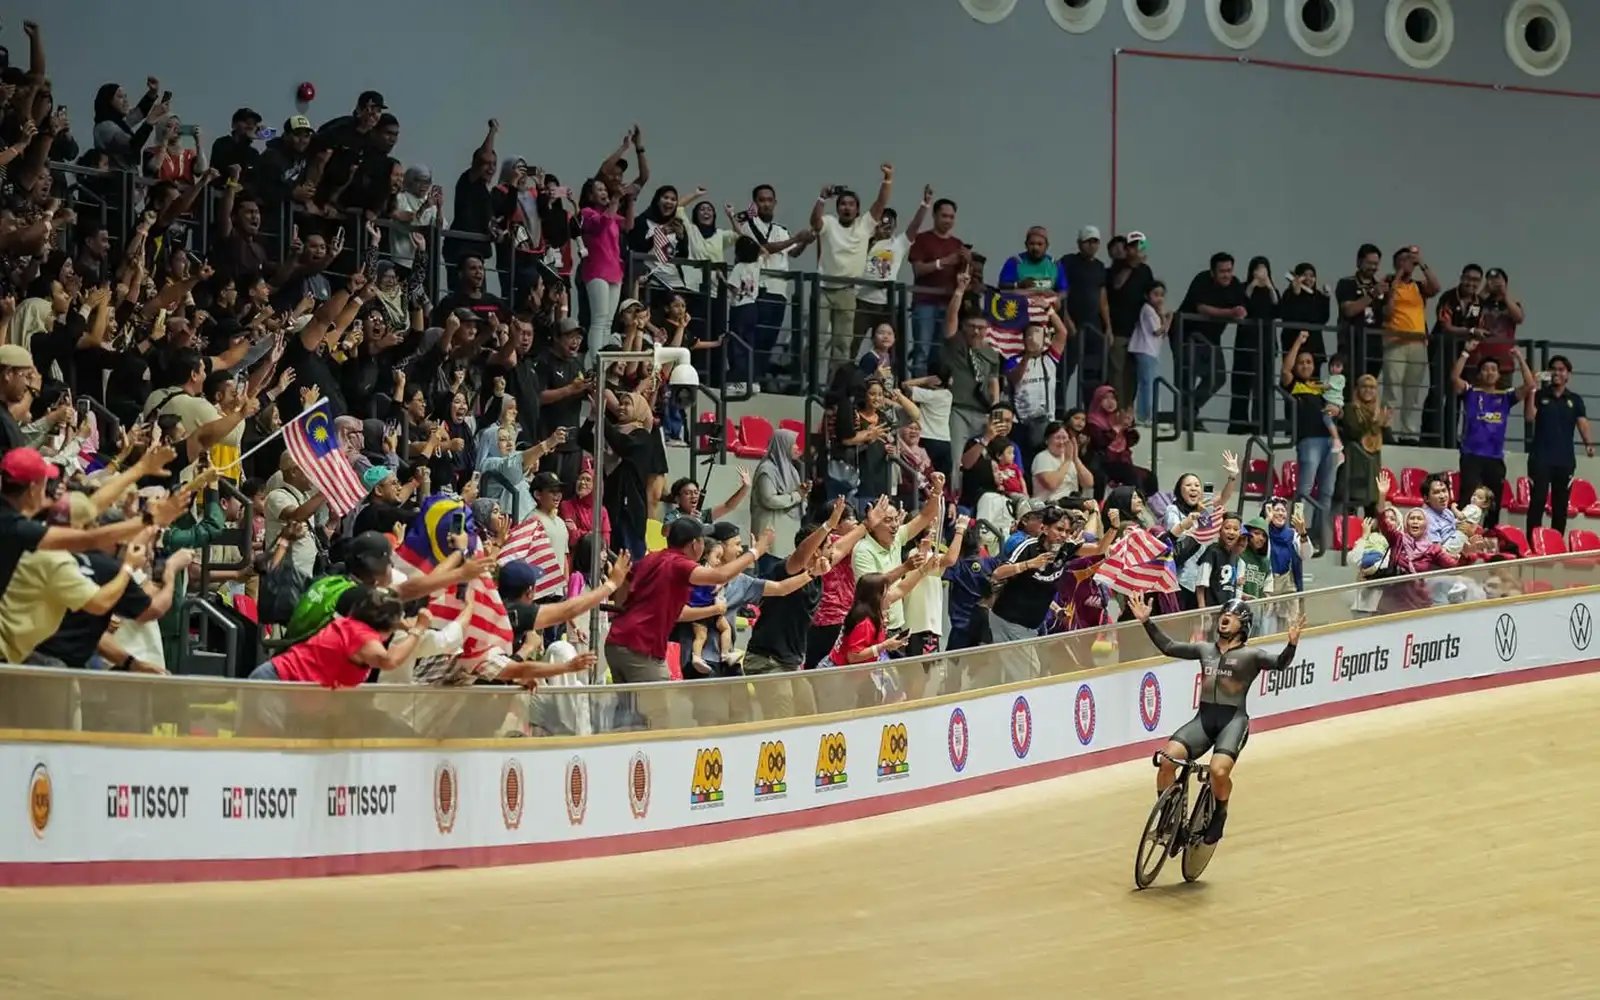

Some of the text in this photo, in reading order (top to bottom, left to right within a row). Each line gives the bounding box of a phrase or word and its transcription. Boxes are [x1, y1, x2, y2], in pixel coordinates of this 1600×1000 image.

[131, 785, 189, 818] TISSOT
[244, 787, 297, 819] TISSOT
[348, 785, 397, 816] TISSOT
